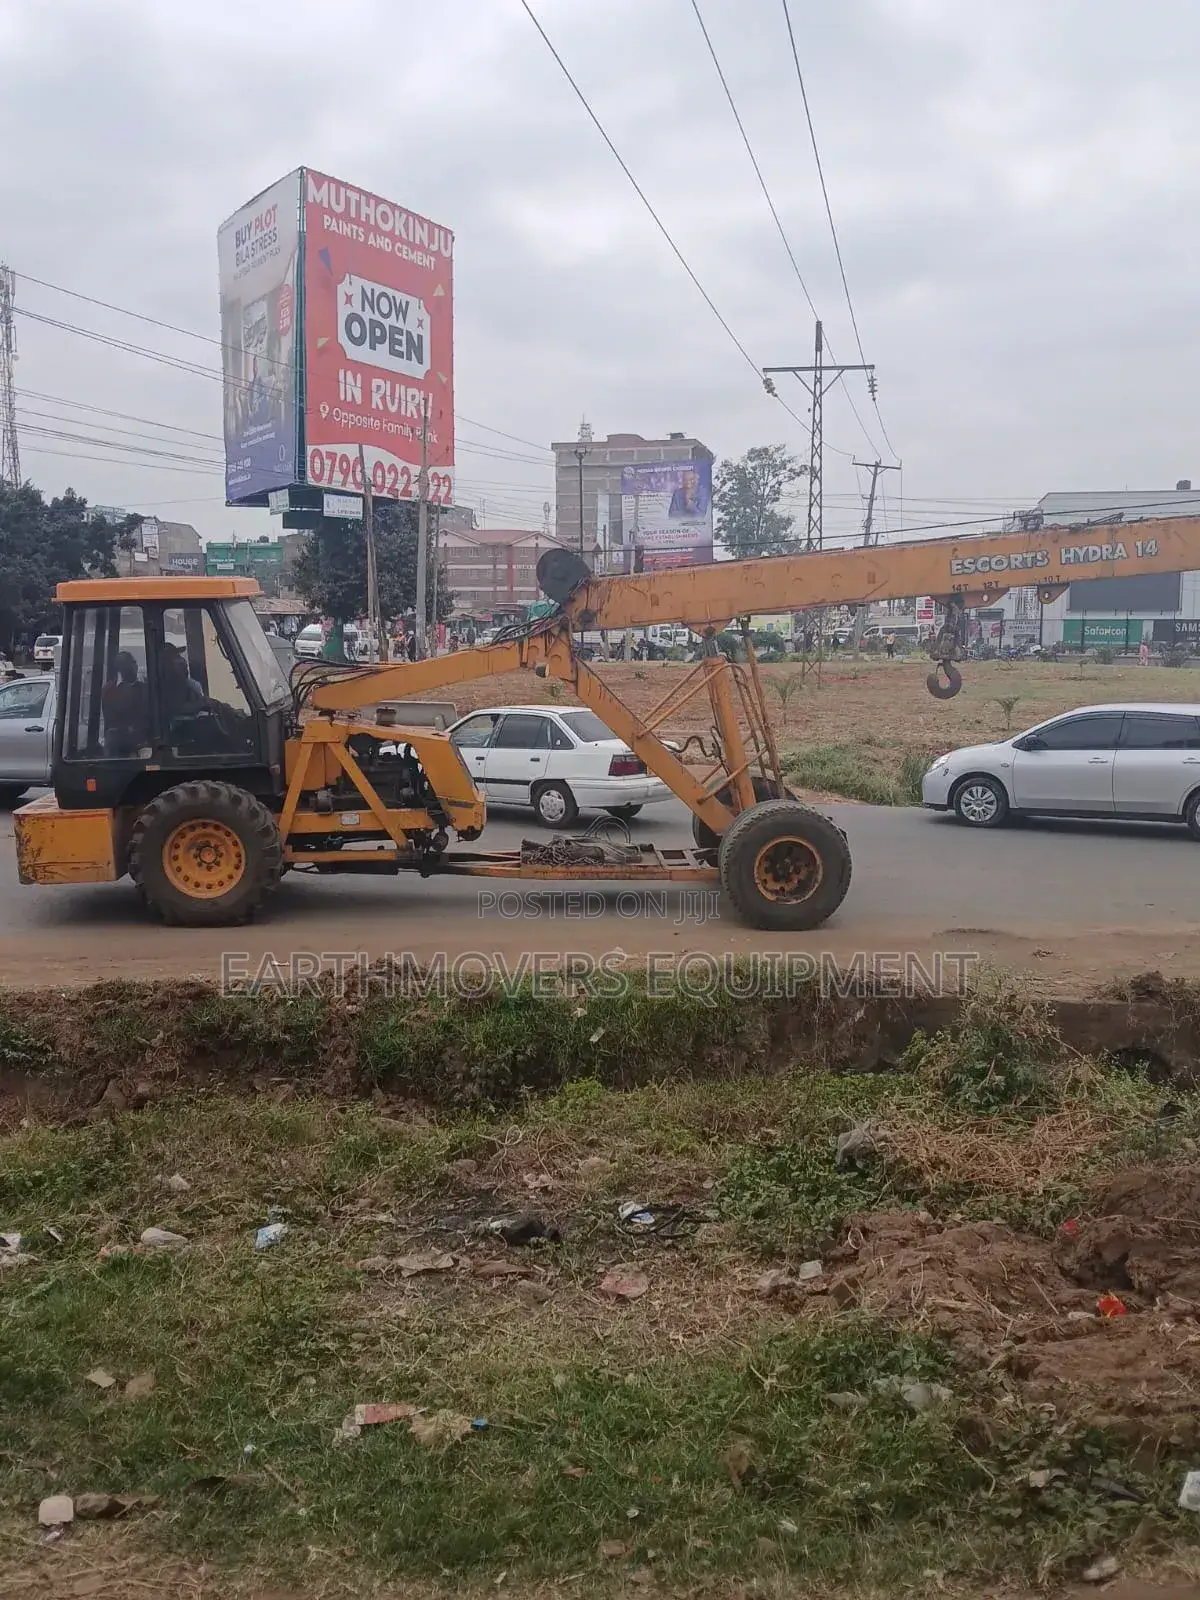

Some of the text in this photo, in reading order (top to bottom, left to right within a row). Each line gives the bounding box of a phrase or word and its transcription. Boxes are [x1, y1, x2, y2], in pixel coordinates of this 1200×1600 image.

[235, 204, 278, 249] BUY PLOT
[307, 174, 452, 258] MUTHOKINJU
[250, 227, 278, 257] STRESS
[323, 214, 436, 271] PAINTS AND CEMENT
[360, 283, 410, 326] NOW
[344, 312, 424, 366] OPEN
[338, 368, 433, 421] IN RUIRU
[332, 407, 439, 444] Opposite Family Bnk
[372, 460, 412, 498] 022
[418, 470, 452, 505] 22
[951, 538, 1158, 576] ESCORTS HYDRA 14
